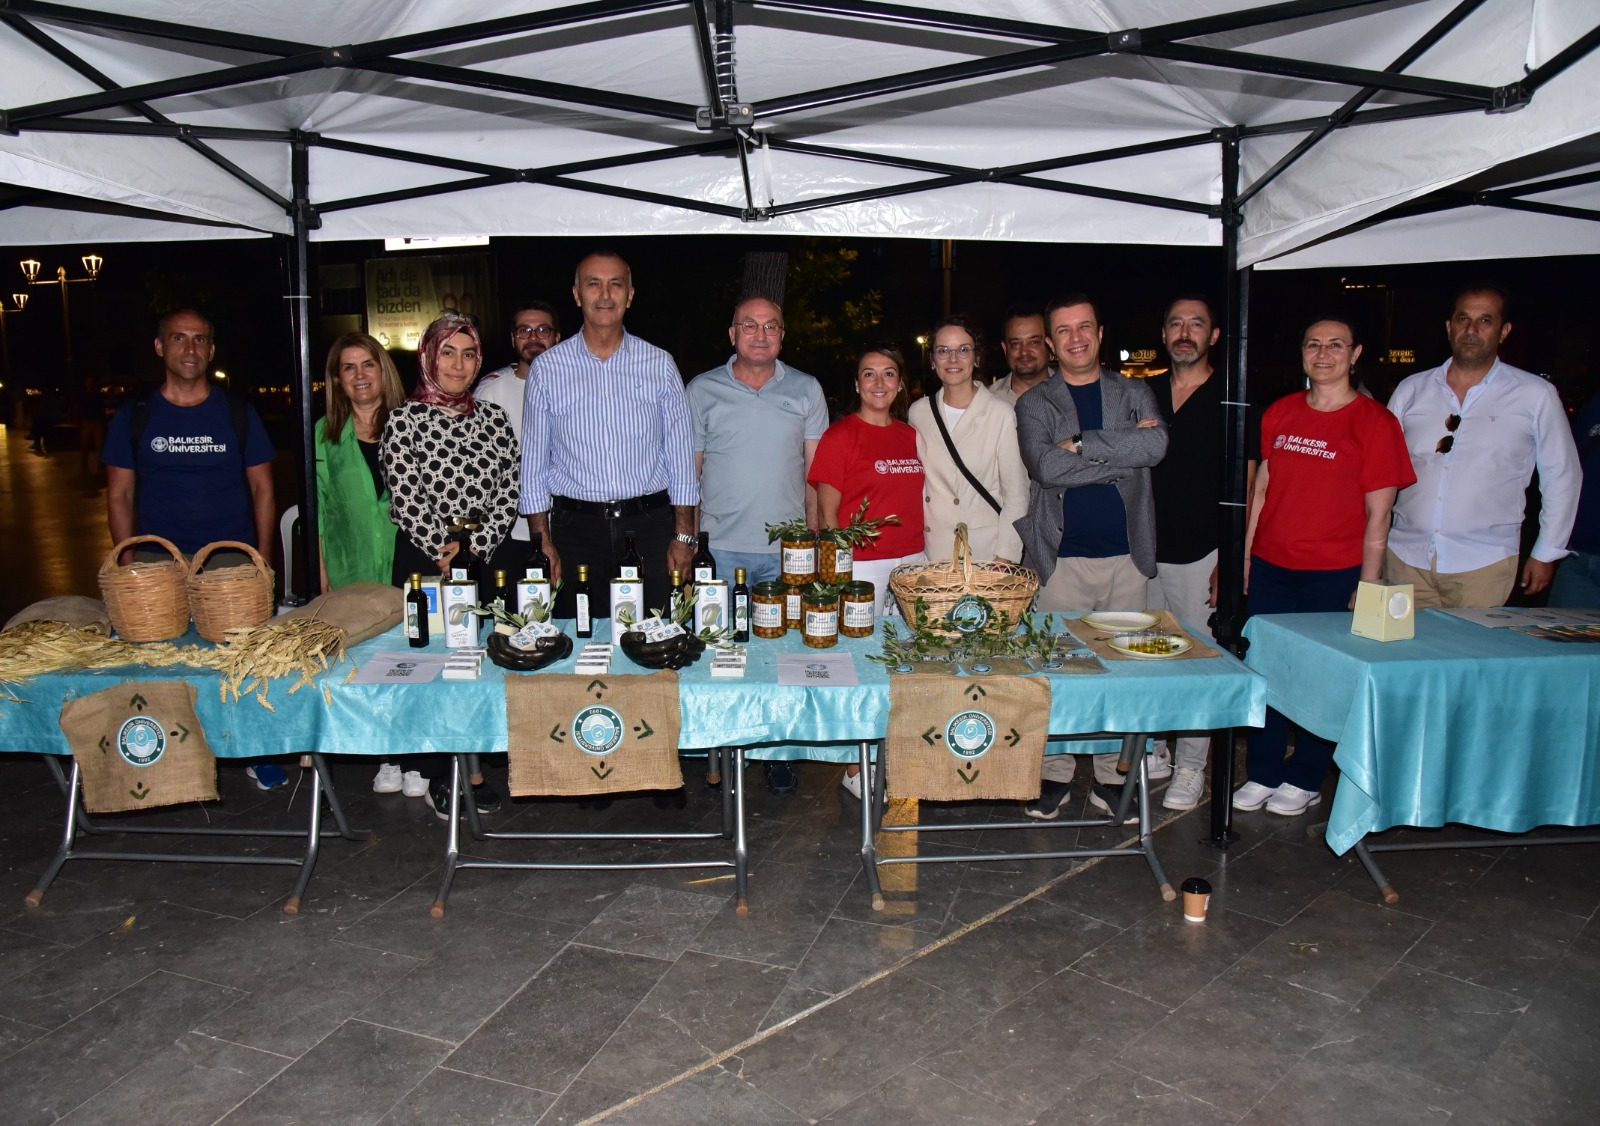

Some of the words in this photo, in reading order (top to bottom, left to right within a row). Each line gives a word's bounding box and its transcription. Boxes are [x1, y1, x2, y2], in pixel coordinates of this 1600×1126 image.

[401, 269, 416, 282] da
[377, 284, 399, 298] tadı
[404, 282, 420, 297] da
[377, 299, 421, 314] bizden
[168, 435, 213, 444] BALIKESİR
[1287, 435, 1328, 449] BALIKESİR
[168, 443, 226, 453] ÜNİVERSİTESİ
[1283, 443, 1337, 460] ÜNİVERSİTESİ
